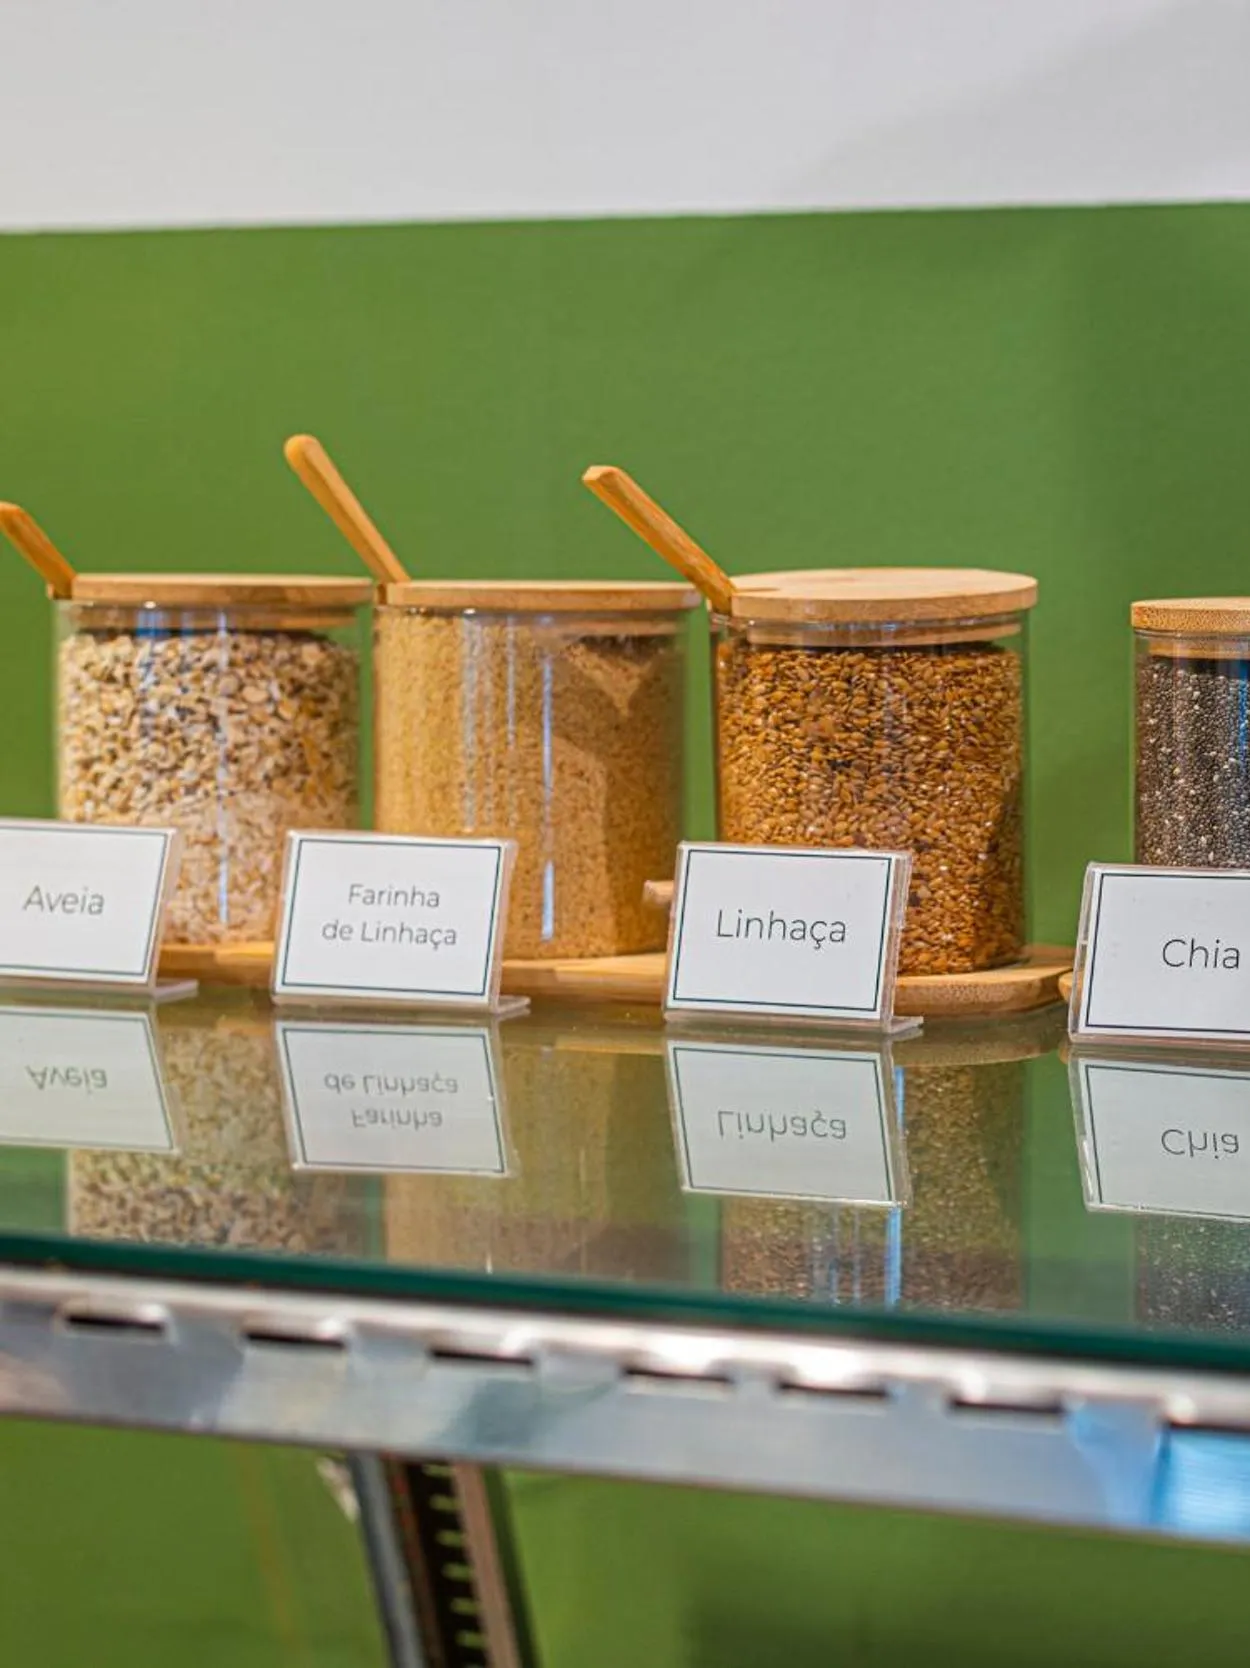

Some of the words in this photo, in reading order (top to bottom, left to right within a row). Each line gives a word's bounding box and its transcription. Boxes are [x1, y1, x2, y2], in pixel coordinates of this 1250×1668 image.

[23, 884, 105, 915] Aveia
[348, 883, 441, 909] Farinha
[321, 918, 354, 942] de
[360, 920, 458, 950] Linhaça
[716, 908, 847, 950] Linhaça
[1162, 937, 1241, 970] Chia
